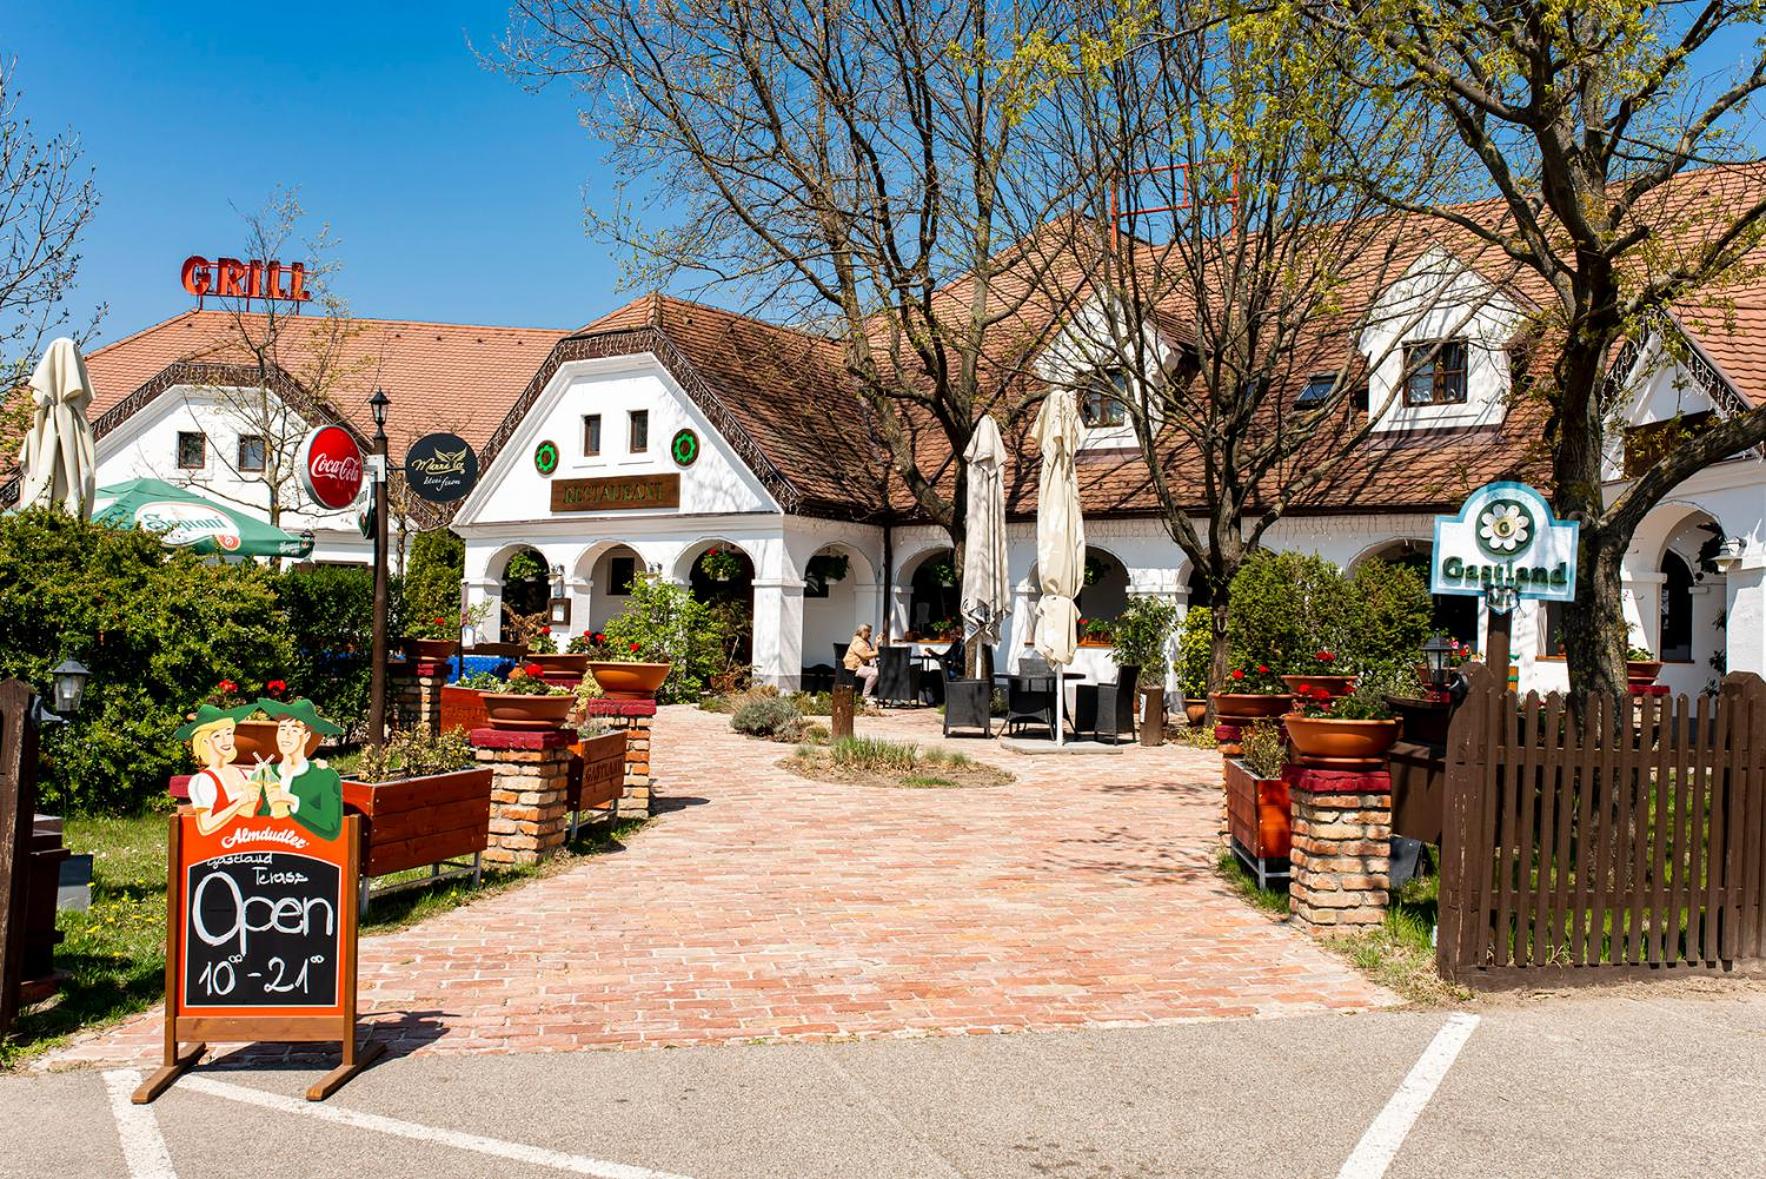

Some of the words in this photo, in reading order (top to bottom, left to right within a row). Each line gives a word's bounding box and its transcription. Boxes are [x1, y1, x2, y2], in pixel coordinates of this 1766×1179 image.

[181, 255, 311, 300] GRILL
[1442, 555, 1568, 587] Gastland
[192, 871, 334, 957] Open
